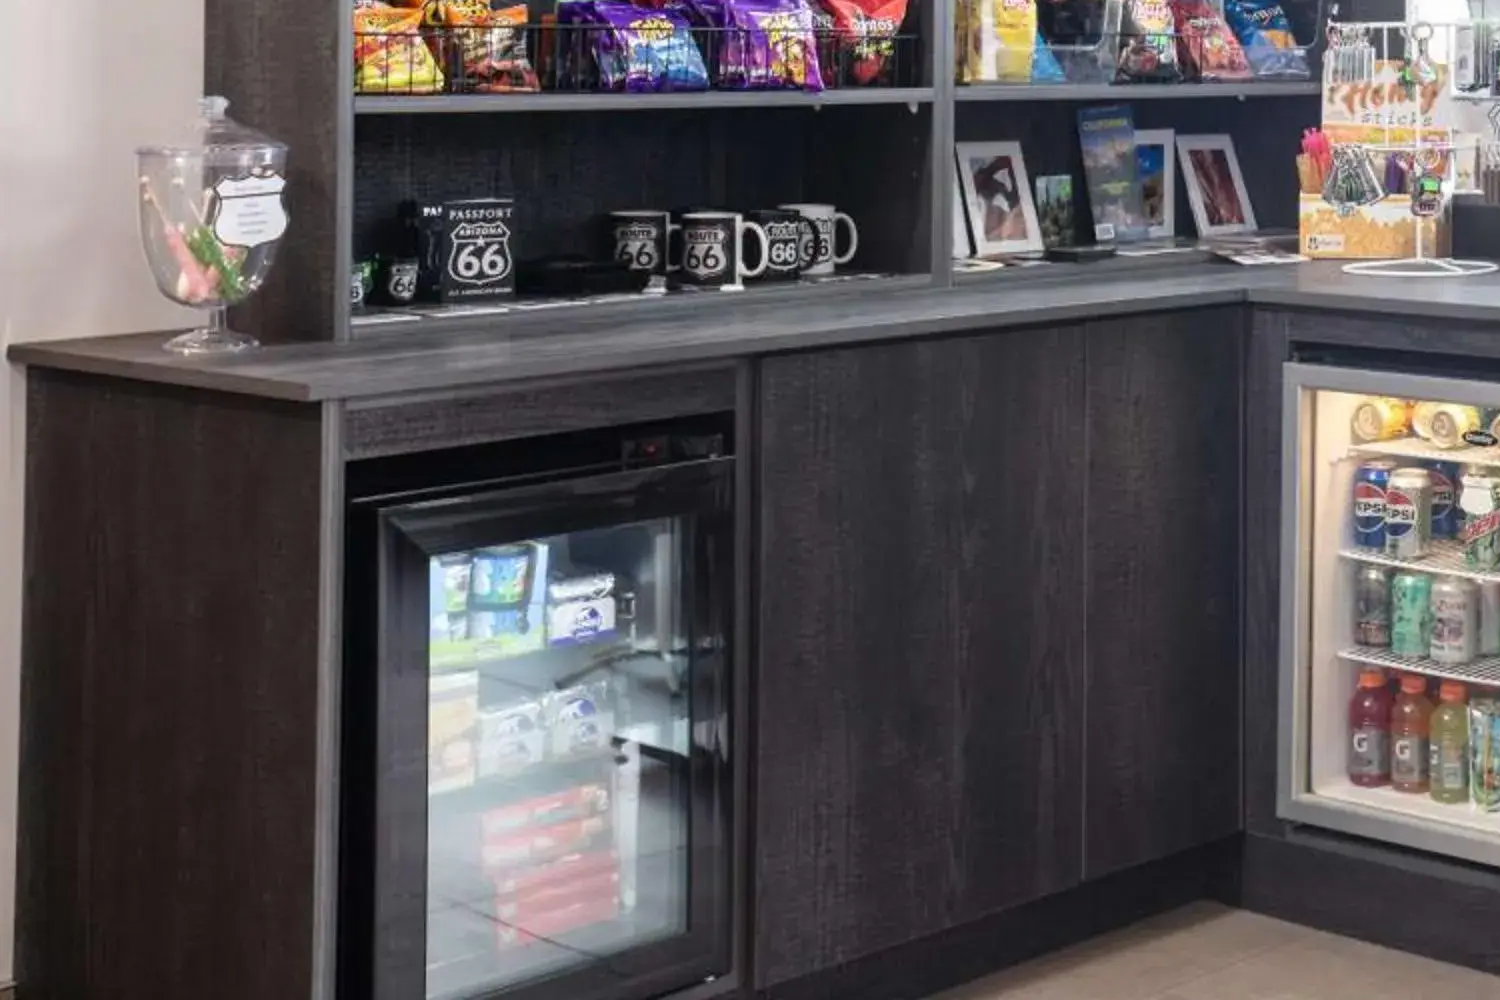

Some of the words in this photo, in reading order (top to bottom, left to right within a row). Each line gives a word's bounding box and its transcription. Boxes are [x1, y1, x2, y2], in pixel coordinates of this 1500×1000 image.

[449, 207, 513, 221] PASSPORT
[457, 243, 506, 278] 66
[618, 242, 654, 266] 66
[686, 246, 720, 270] 66
[771, 242, 797, 264] 66
[1353, 733, 1368, 753] G
[1395, 740, 1411, 760] G
